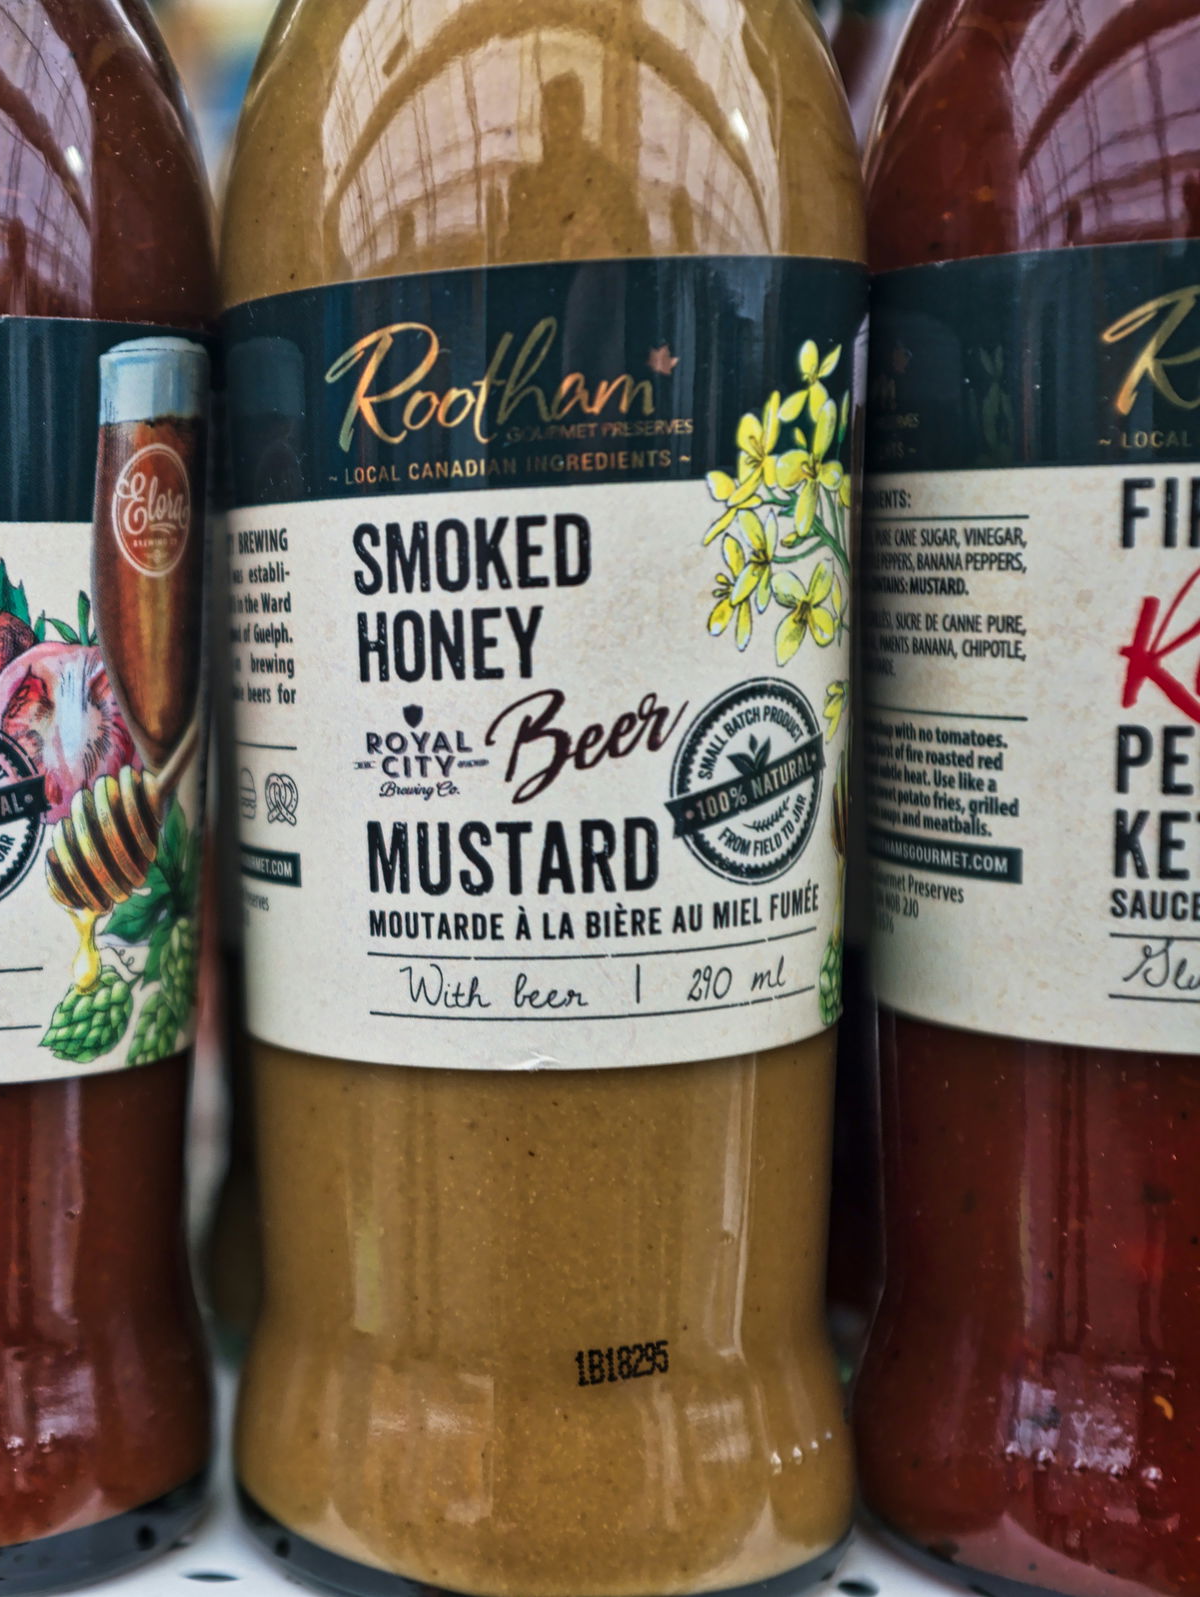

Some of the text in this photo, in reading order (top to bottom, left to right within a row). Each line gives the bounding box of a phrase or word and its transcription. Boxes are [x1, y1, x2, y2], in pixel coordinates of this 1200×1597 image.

[324, 316, 655, 453] Rootham
[506, 418, 694, 443] GOURMET PRESERVES
[1120, 431, 1192, 448] LOCAL
[344, 449, 672, 485] LOCAL CANADIAN INGREDIENTS
[116, 471, 191, 535] Elora
[237, 528, 288, 555] BREWING
[894, 527, 917, 546] CANE
[920, 527, 961, 549] SUGAR,
[963, 526, 1028, 549] VINEGAR,
[353, 512, 592, 596] SMOKED
[917, 552, 962, 571] BANANA
[964, 552, 1028, 574] PEPPERS,
[248, 561, 291, 584] establi-
[909, 576, 970, 597] MUSTARD.
[260, 591, 292, 614] Ward
[253, 622, 293, 649] Guelph.
[895, 612, 922, 631] SUCRE
[925, 613, 939, 632] DE
[942, 614, 982, 634] CANNE
[986, 615, 1027, 637] PURE,
[358, 605, 543, 685] HONEY
[912, 636, 958, 660] BANANA,
[961, 639, 1027, 662] CHIPOTLE,
[250, 652, 295, 679] brewing
[277, 682, 297, 704] for
[366, 730, 473, 755] ROYAL
[484, 687, 690, 805] Beer
[697, 704, 804, 781] SMALL BATCH PRODUCT
[894, 721, 917, 742] with
[918, 727, 933, 743] no
[935, 726, 1008, 750] tomatoes.
[381, 755, 456, 778] CITY
[894, 744, 905, 760] of
[905, 744, 924, 763] fire
[925, 750, 975, 769] roasted
[977, 751, 1004, 772] red
[378, 780, 461, 801] Brewing Co.
[696, 783, 748, 821] 100%
[751, 750, 813, 800] NATURAL
[903, 765, 931, 787] heat.
[933, 769, 957, 790] Use
[957, 771, 986, 794] like
[987, 778, 998, 794] a
[897, 787, 932, 809] potato
[932, 790, 966, 815] fries,
[967, 795, 1020, 818] grilled
[717, 792, 807, 858] FROM FIELD TO JAR
[902, 810, 921, 829] and
[922, 813, 993, 838] meatballs.
[366, 815, 660, 897] MUSTARD
[907, 873, 965, 903] Preserves
[368, 883, 820, 941] MOUTARDE À LA BIÈRE AU MIEL FUMÉE
[398, 962, 589, 1010] With beer
[686, 956, 787, 1002] 290 ml
[575, 1339, 668, 1388] 1B18295
